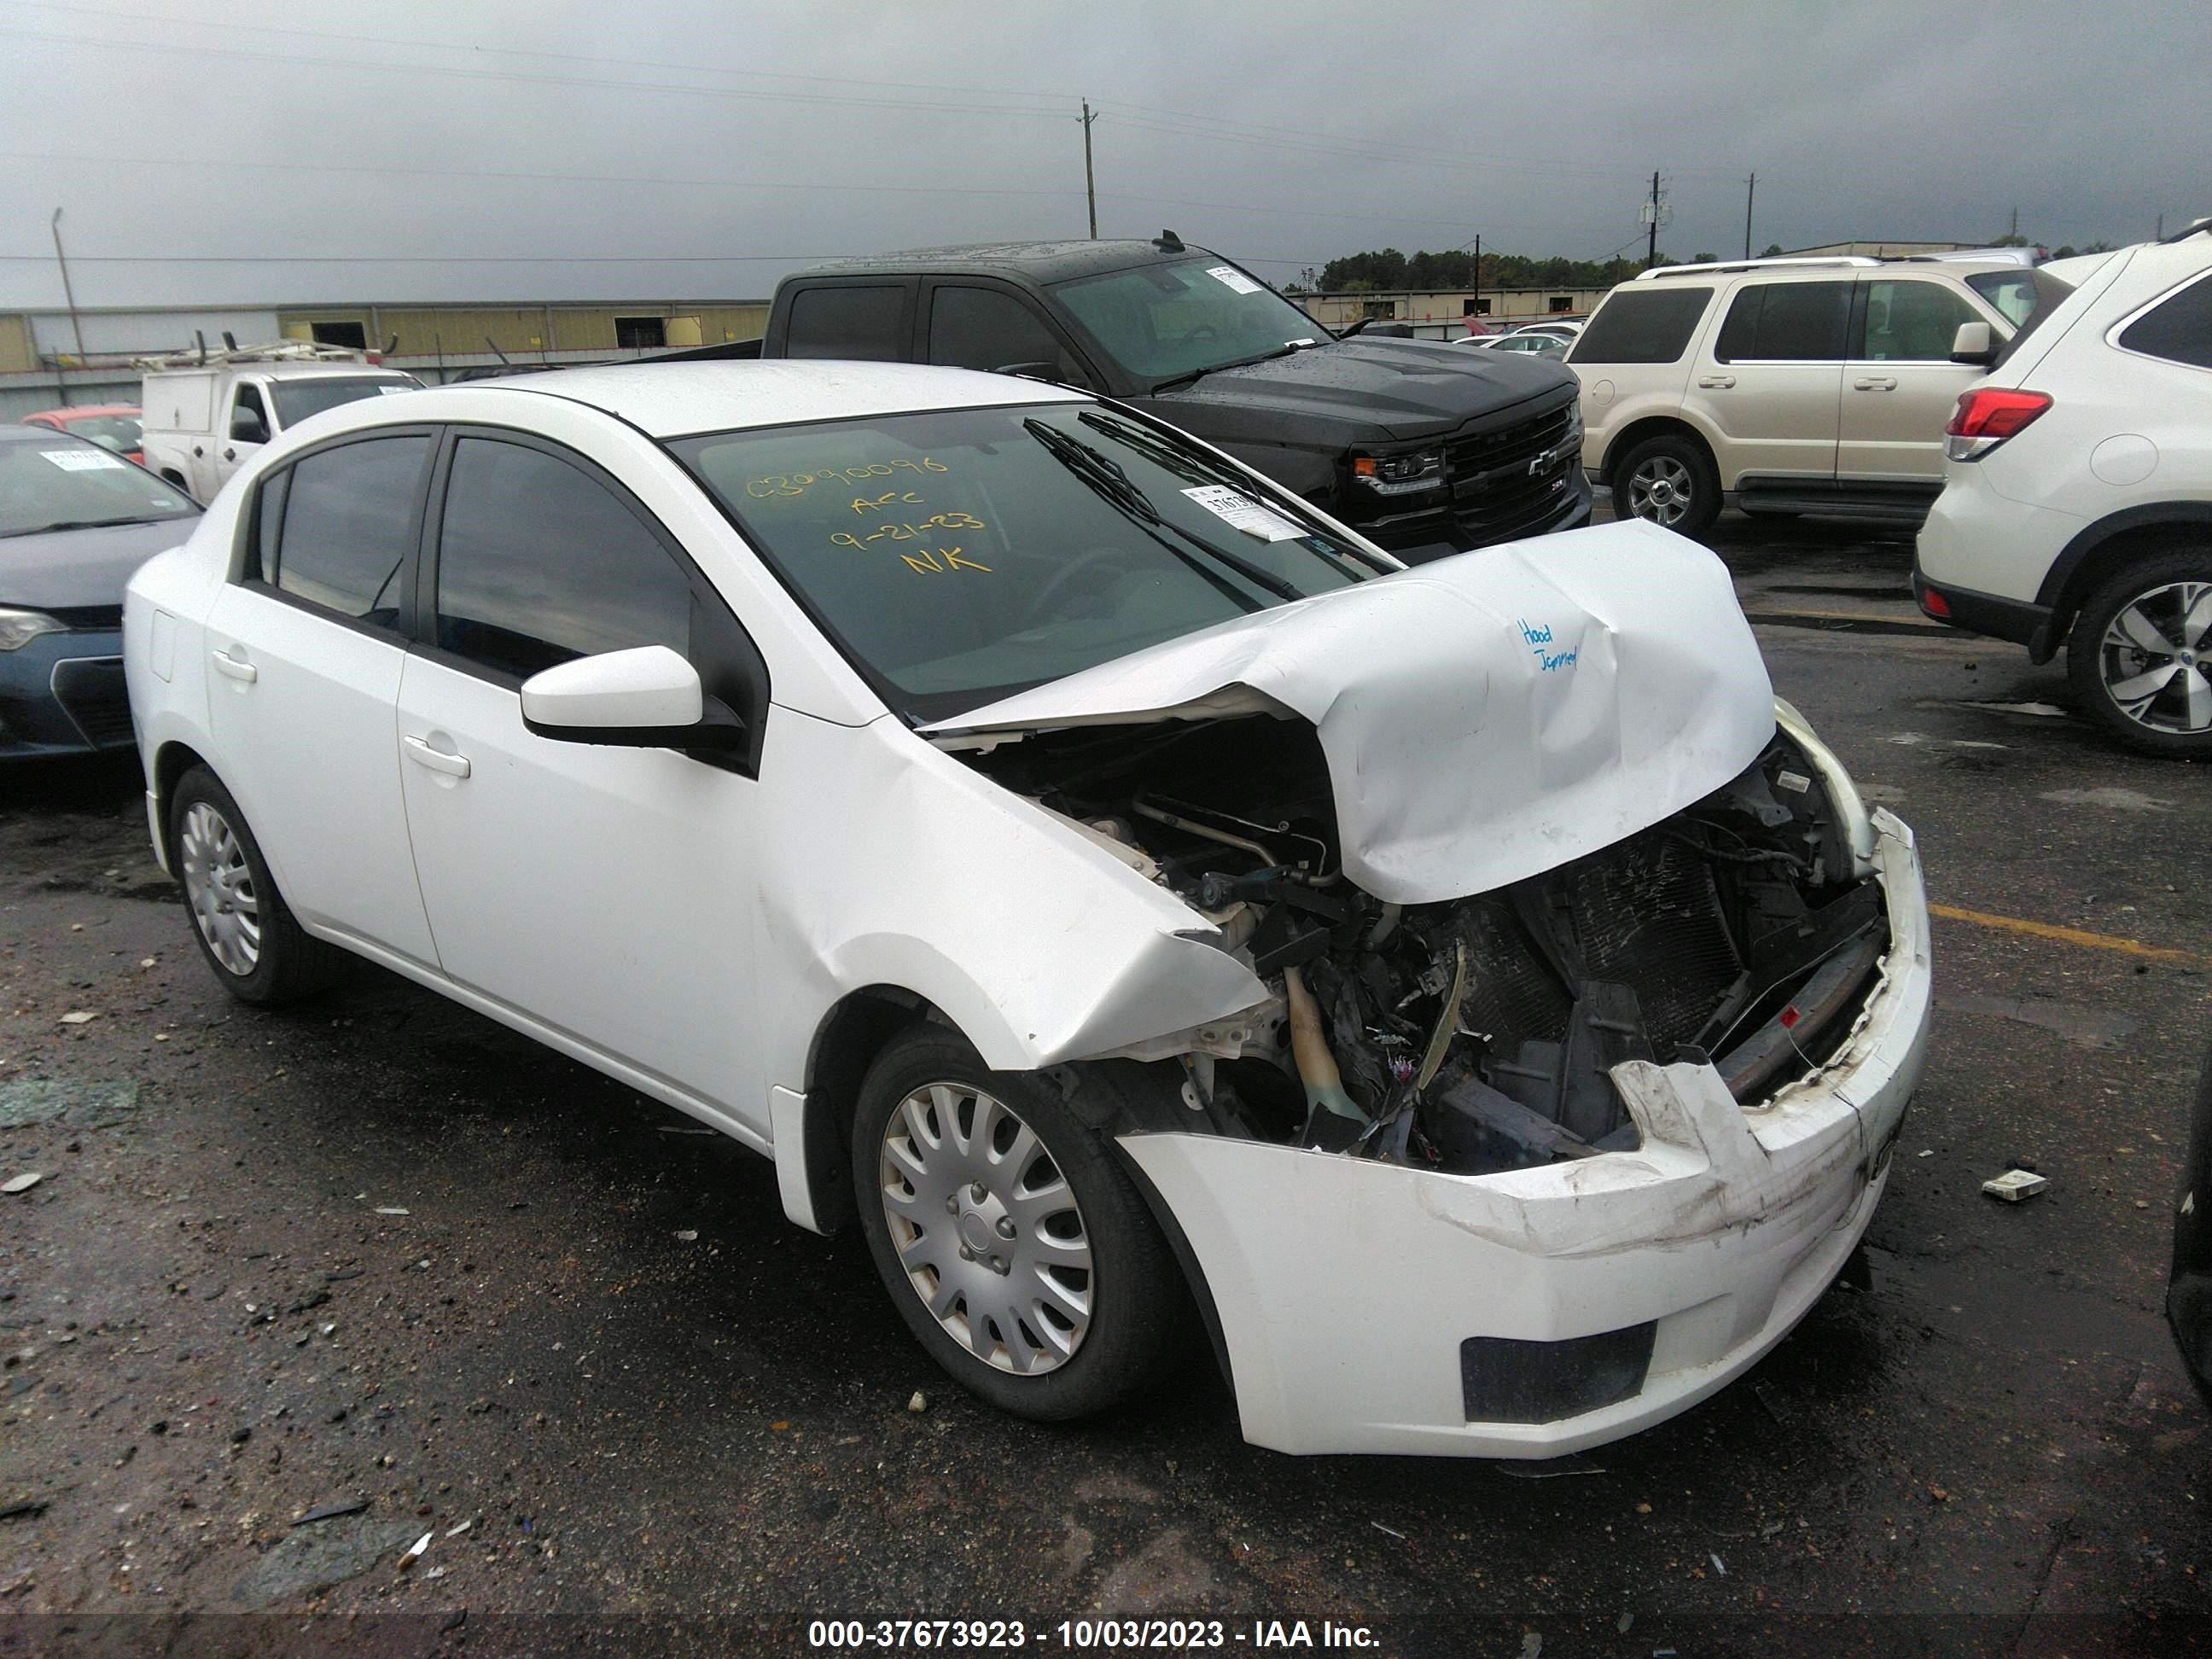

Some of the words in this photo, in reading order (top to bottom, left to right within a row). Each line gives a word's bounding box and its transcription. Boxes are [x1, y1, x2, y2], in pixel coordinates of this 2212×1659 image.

[830, 512, 985, 550] 9-21-23
[900, 547, 993, 574] NK
[1516, 618, 1553, 645] Hood
